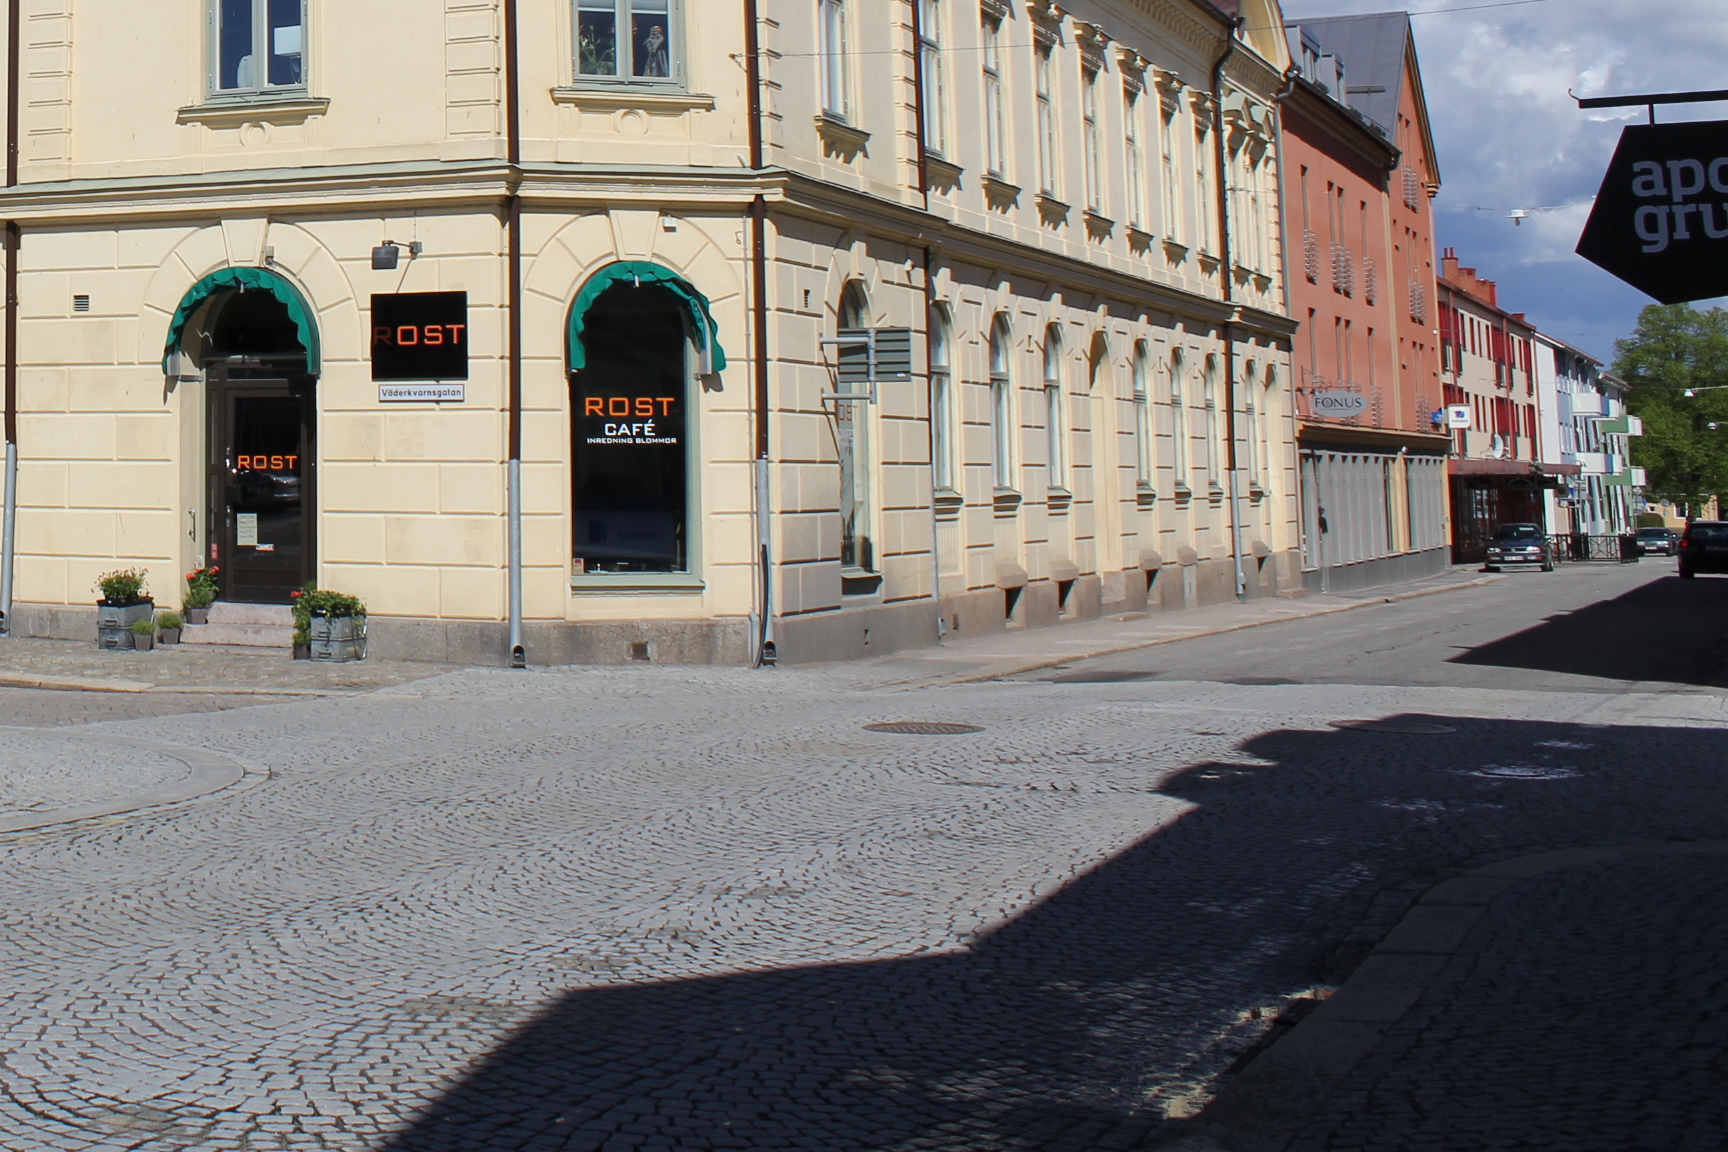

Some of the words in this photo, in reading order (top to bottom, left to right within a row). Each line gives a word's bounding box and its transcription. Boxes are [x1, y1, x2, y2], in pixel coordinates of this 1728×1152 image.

[1634, 203, 1728, 253] gru
[373, 324, 465, 346] ROST
[381, 388, 462, 399] Väderkvarnsgatan
[585, 397, 675, 416] ROST
[1314, 397, 1362, 408] FONUS
[604, 419, 656, 436] CAFÉ
[237, 455, 298, 469] ROST
